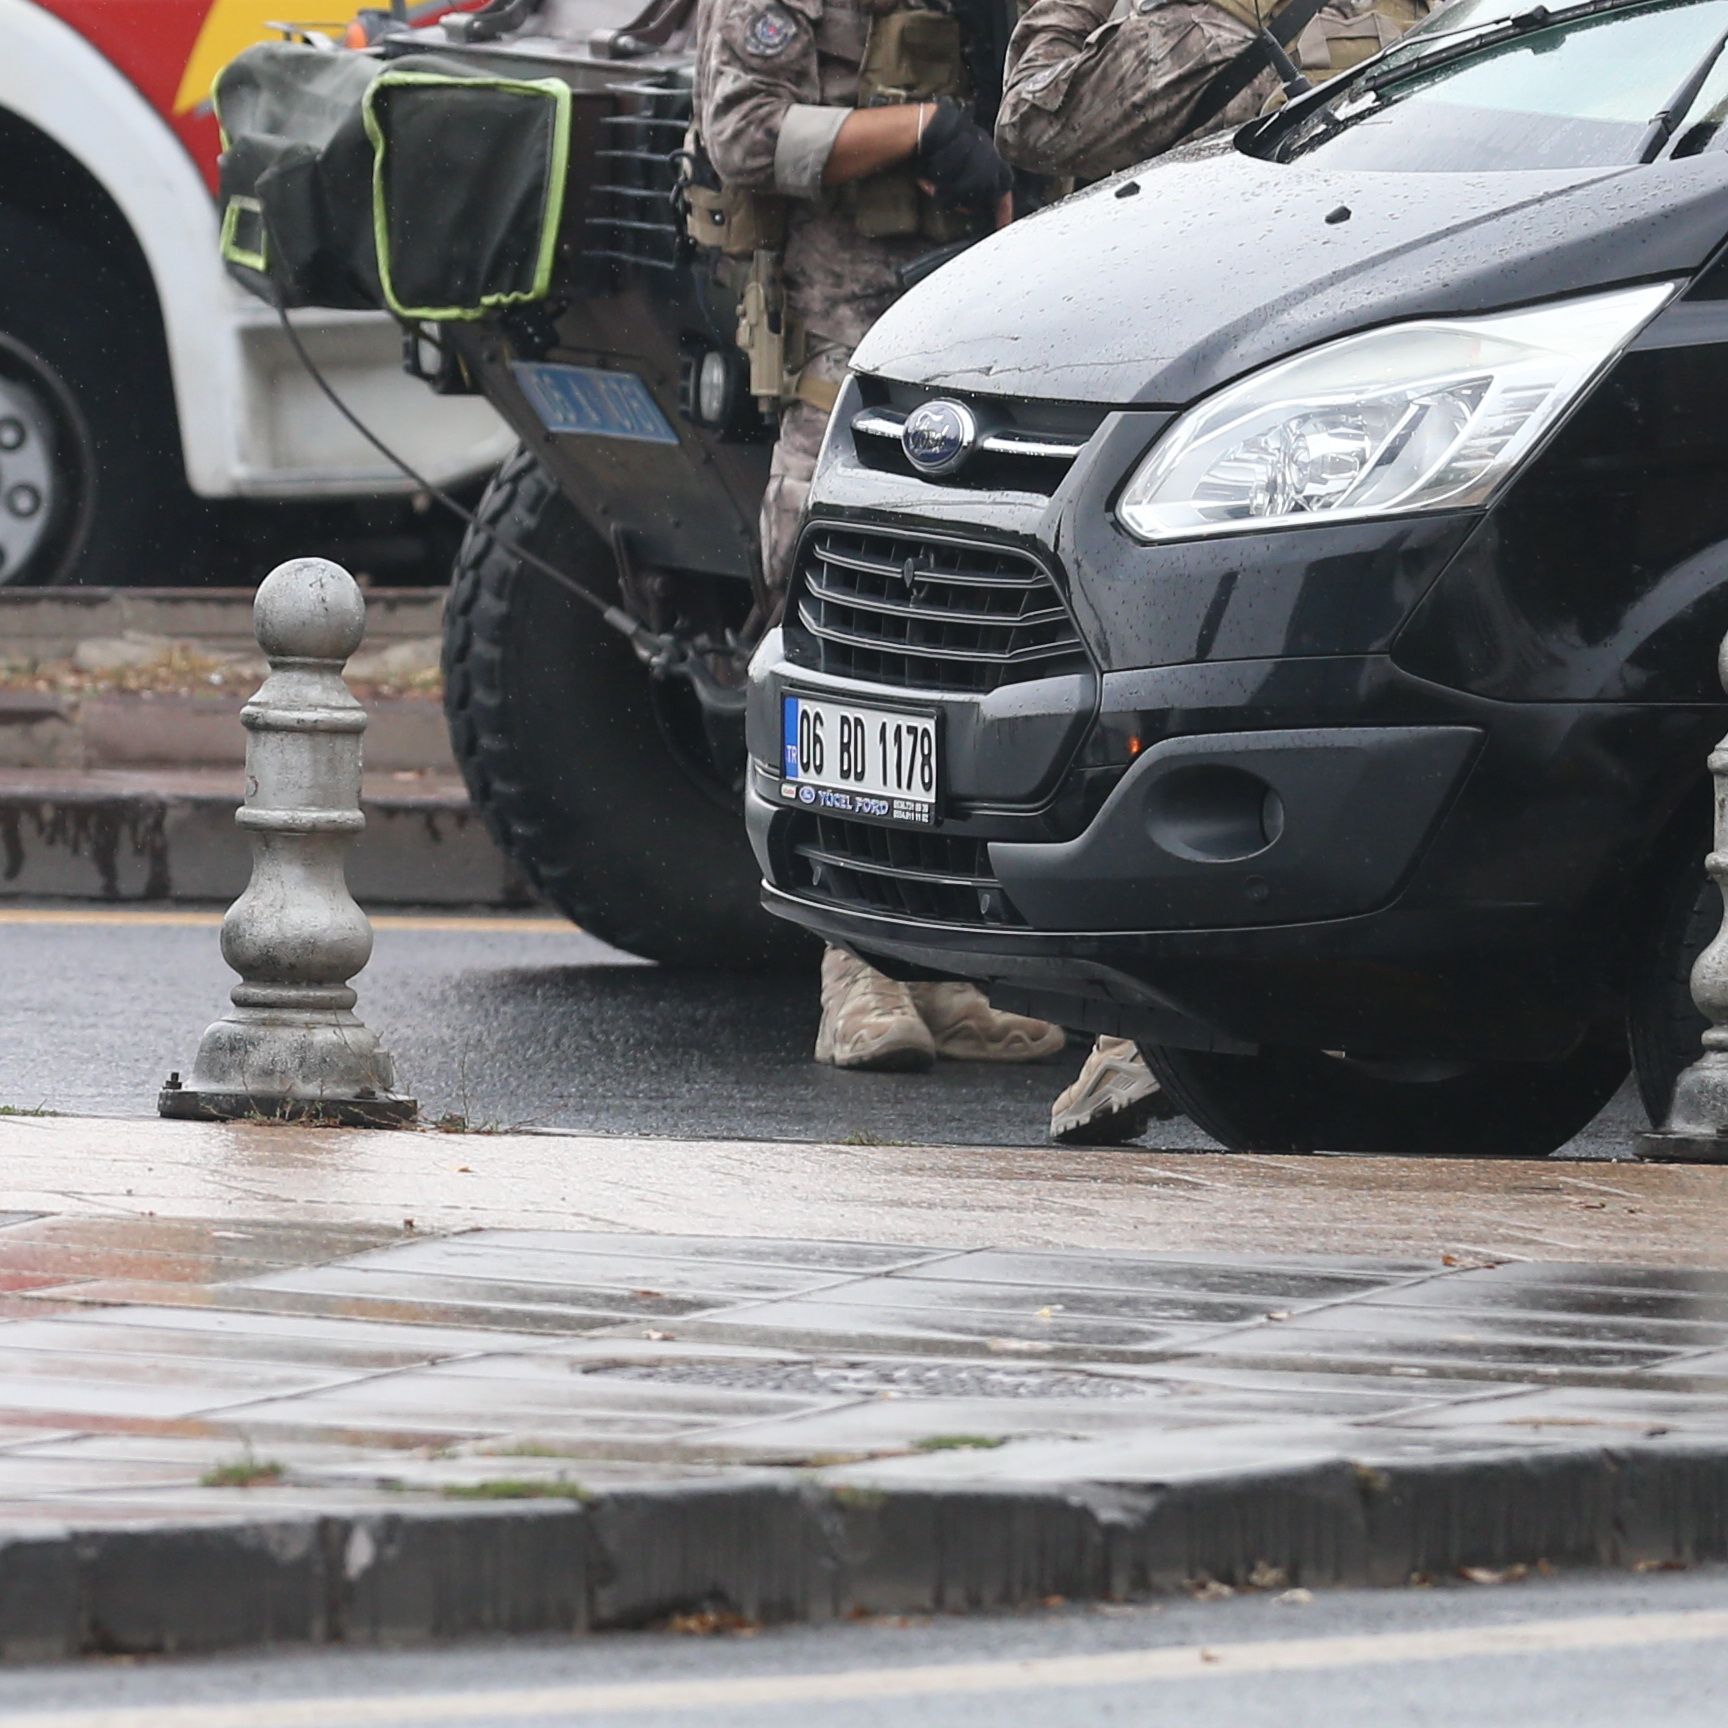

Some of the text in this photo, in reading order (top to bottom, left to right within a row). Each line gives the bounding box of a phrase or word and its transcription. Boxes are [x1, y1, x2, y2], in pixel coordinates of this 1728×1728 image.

[785, 744, 798, 764] TR
[799, 707, 934, 792] 06 BD 1178
[854, 796, 889, 816] FORD
